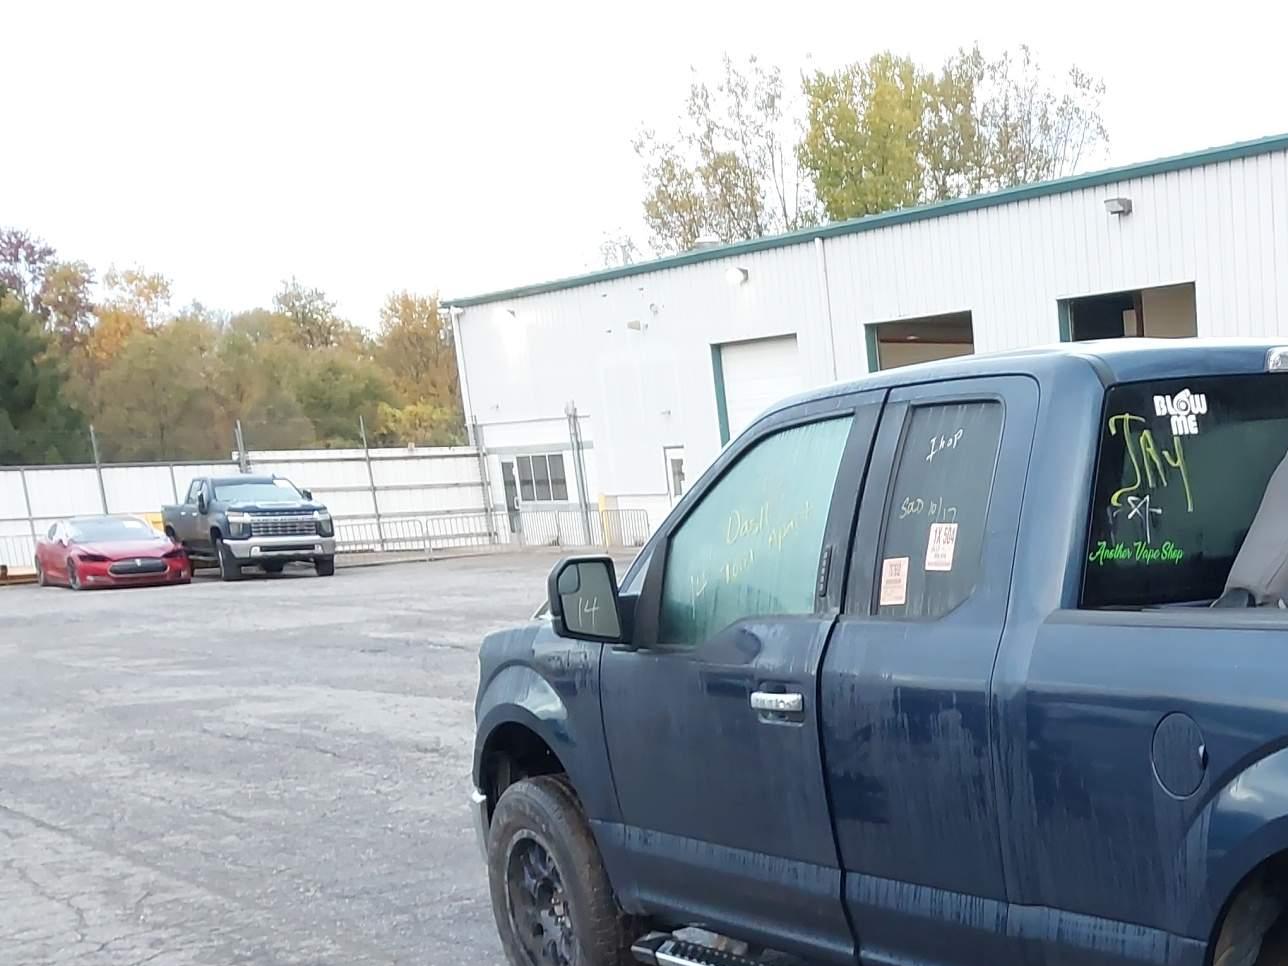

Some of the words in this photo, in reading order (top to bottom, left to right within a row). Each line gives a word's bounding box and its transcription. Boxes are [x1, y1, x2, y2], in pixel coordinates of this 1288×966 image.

[1153, 388, 1208, 416] BLOW
[1170, 414, 1199, 435] ME
[1133, 540, 1161, 565] Vape
[1160, 540, 1184, 564] Shop
[578, 596, 600, 626] 14
